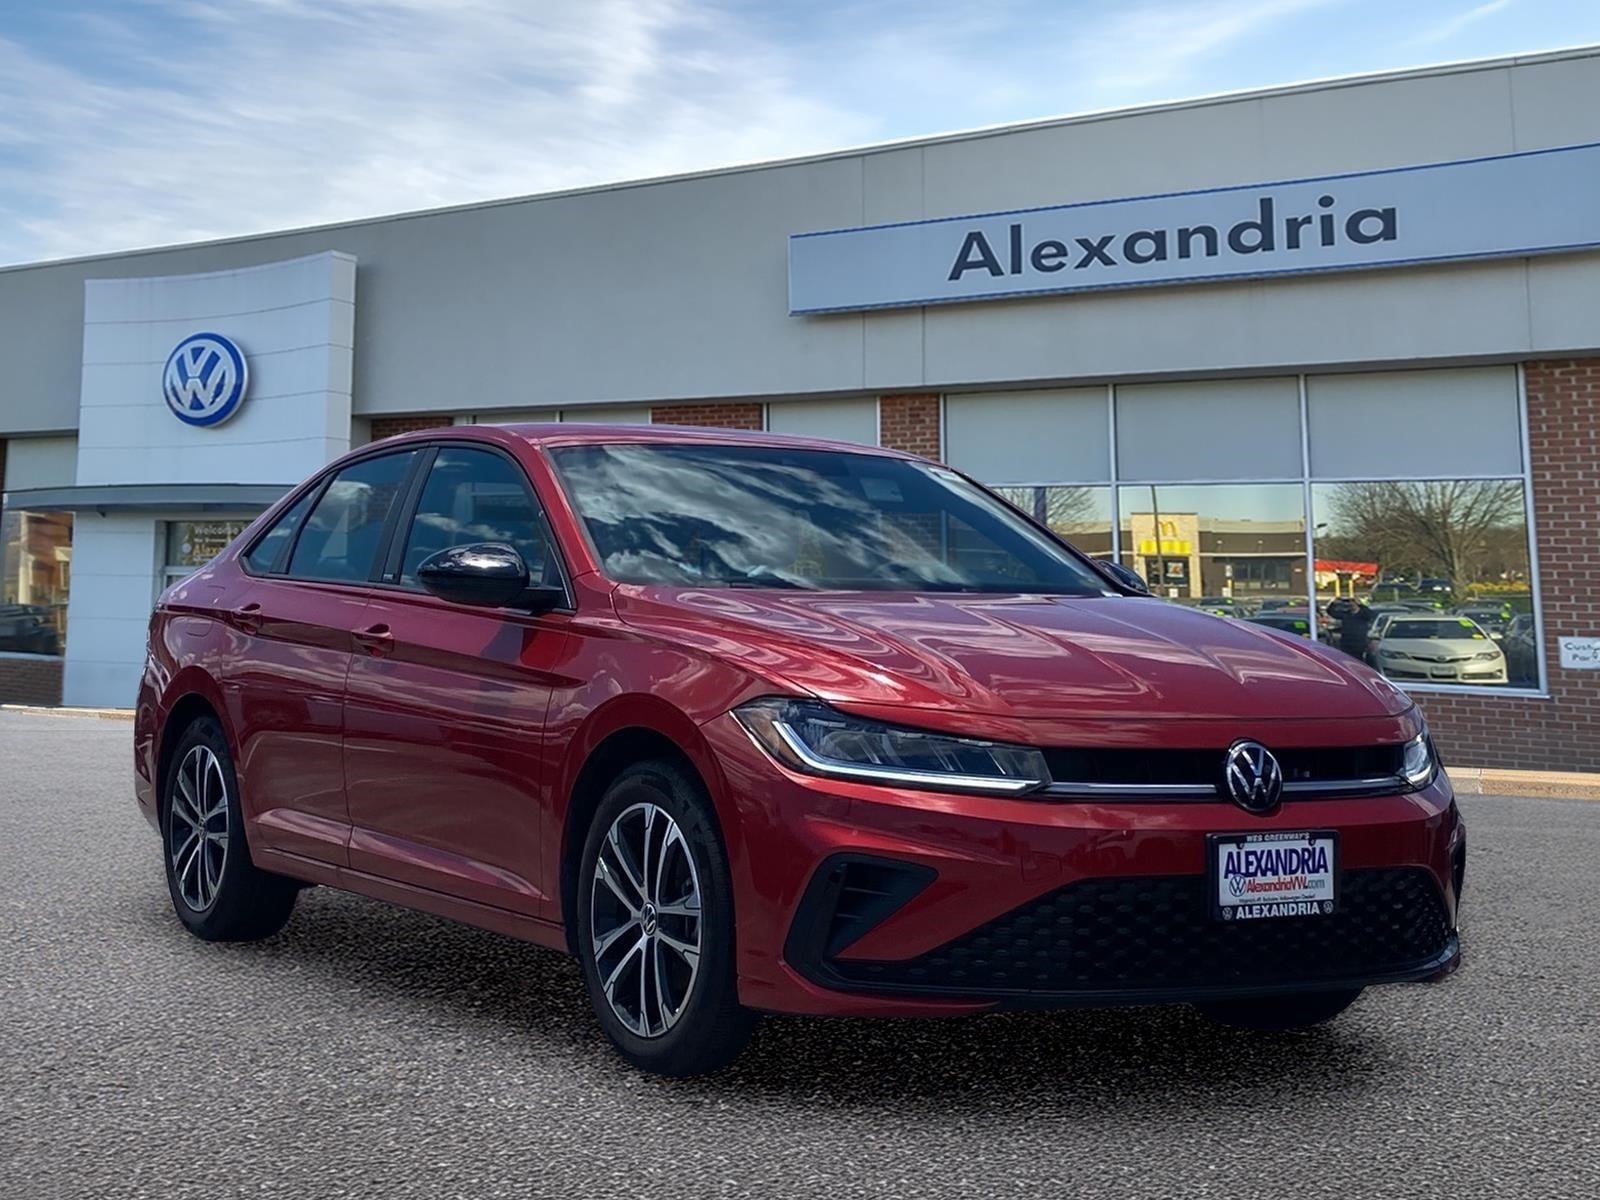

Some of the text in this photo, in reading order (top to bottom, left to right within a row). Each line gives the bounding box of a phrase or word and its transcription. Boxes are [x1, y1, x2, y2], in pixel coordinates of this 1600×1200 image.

[947, 194, 1398, 281] Alexandria
[1224, 846, 1329, 879] ALEXANDRIA
[1246, 876, 1326, 893] AlexandriaVW.com
[1236, 901, 1321, 920] ALEXANDRIA
